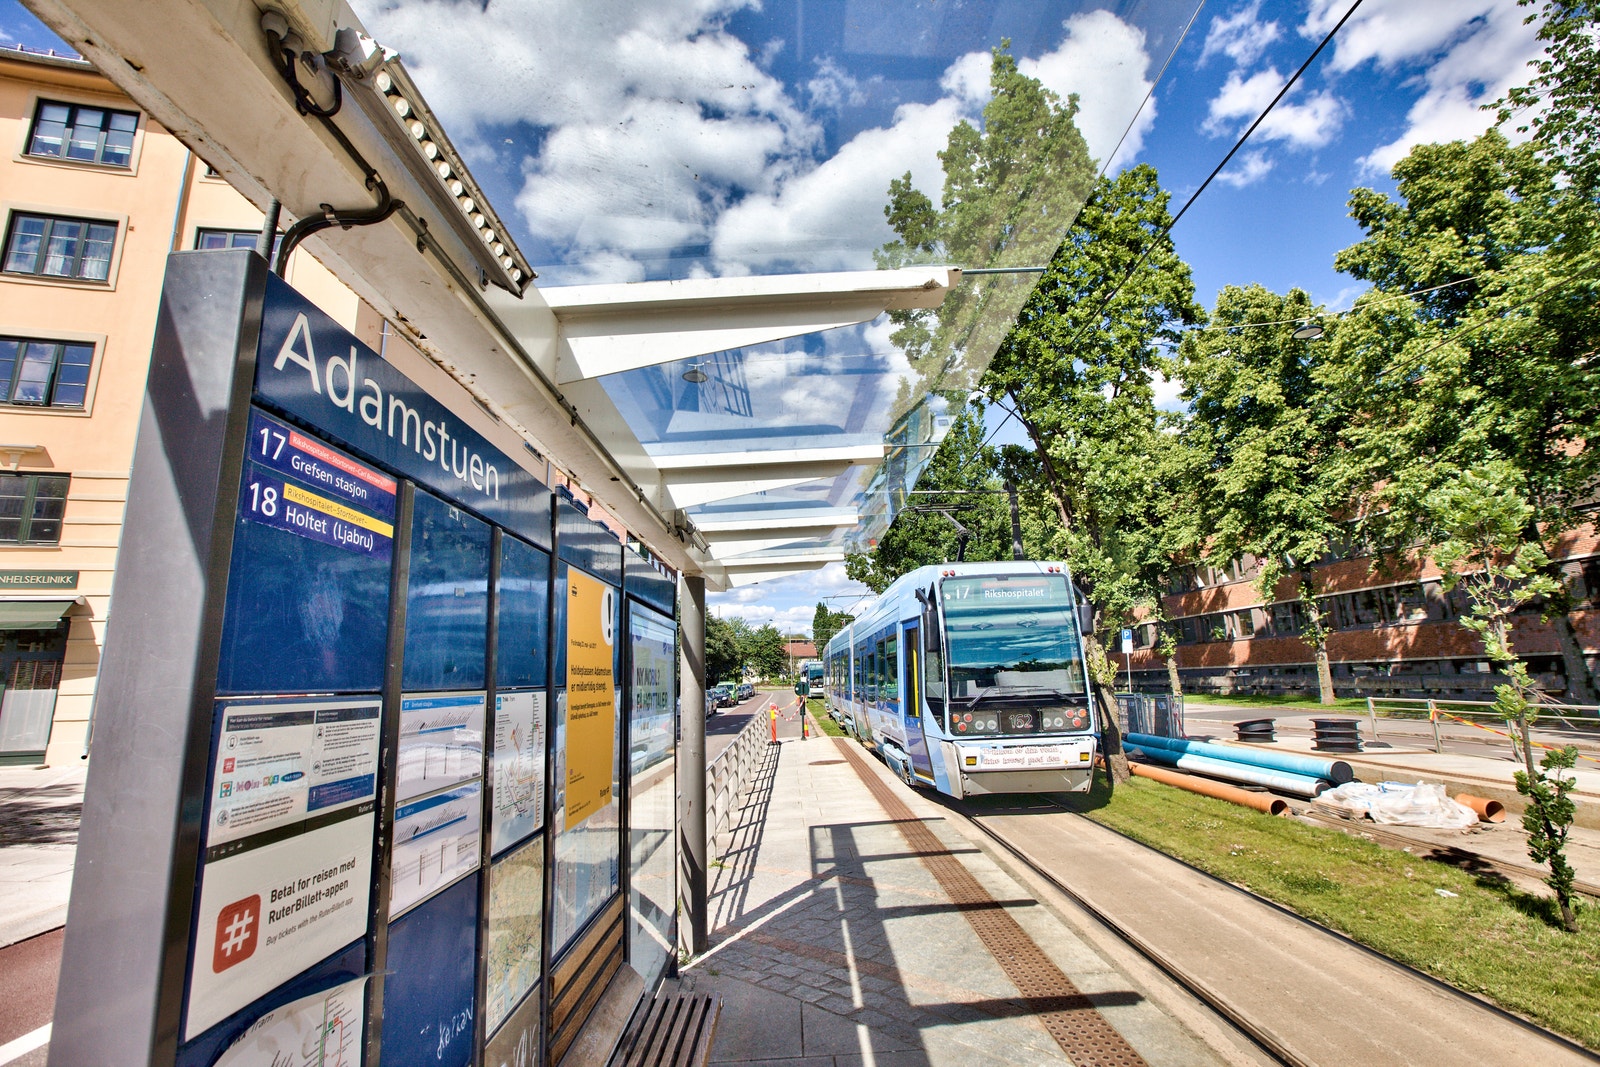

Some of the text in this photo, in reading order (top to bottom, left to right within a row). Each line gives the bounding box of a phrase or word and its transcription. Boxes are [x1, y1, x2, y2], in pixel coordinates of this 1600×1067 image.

[273, 311, 499, 501] Adamstuen
[260, 427, 286, 460] 17
[291, 455, 367, 499] Grefsen stasjon
[250, 482, 277, 517] 18
[285, 505, 374, 552] Holtet (Ljabru)
[955, 585, 1045, 599] 17 Rikshospitalet
[1009, 713, 1034, 729] 162
[270, 857, 356, 904] Betal for reisen med
[268, 879, 349, 925] RuterBillett-appen
[266, 934, 278, 946] Buy
[278, 924, 297, 940] tickets
[297, 918, 309, 930] with
[309, 914, 318, 924] the
